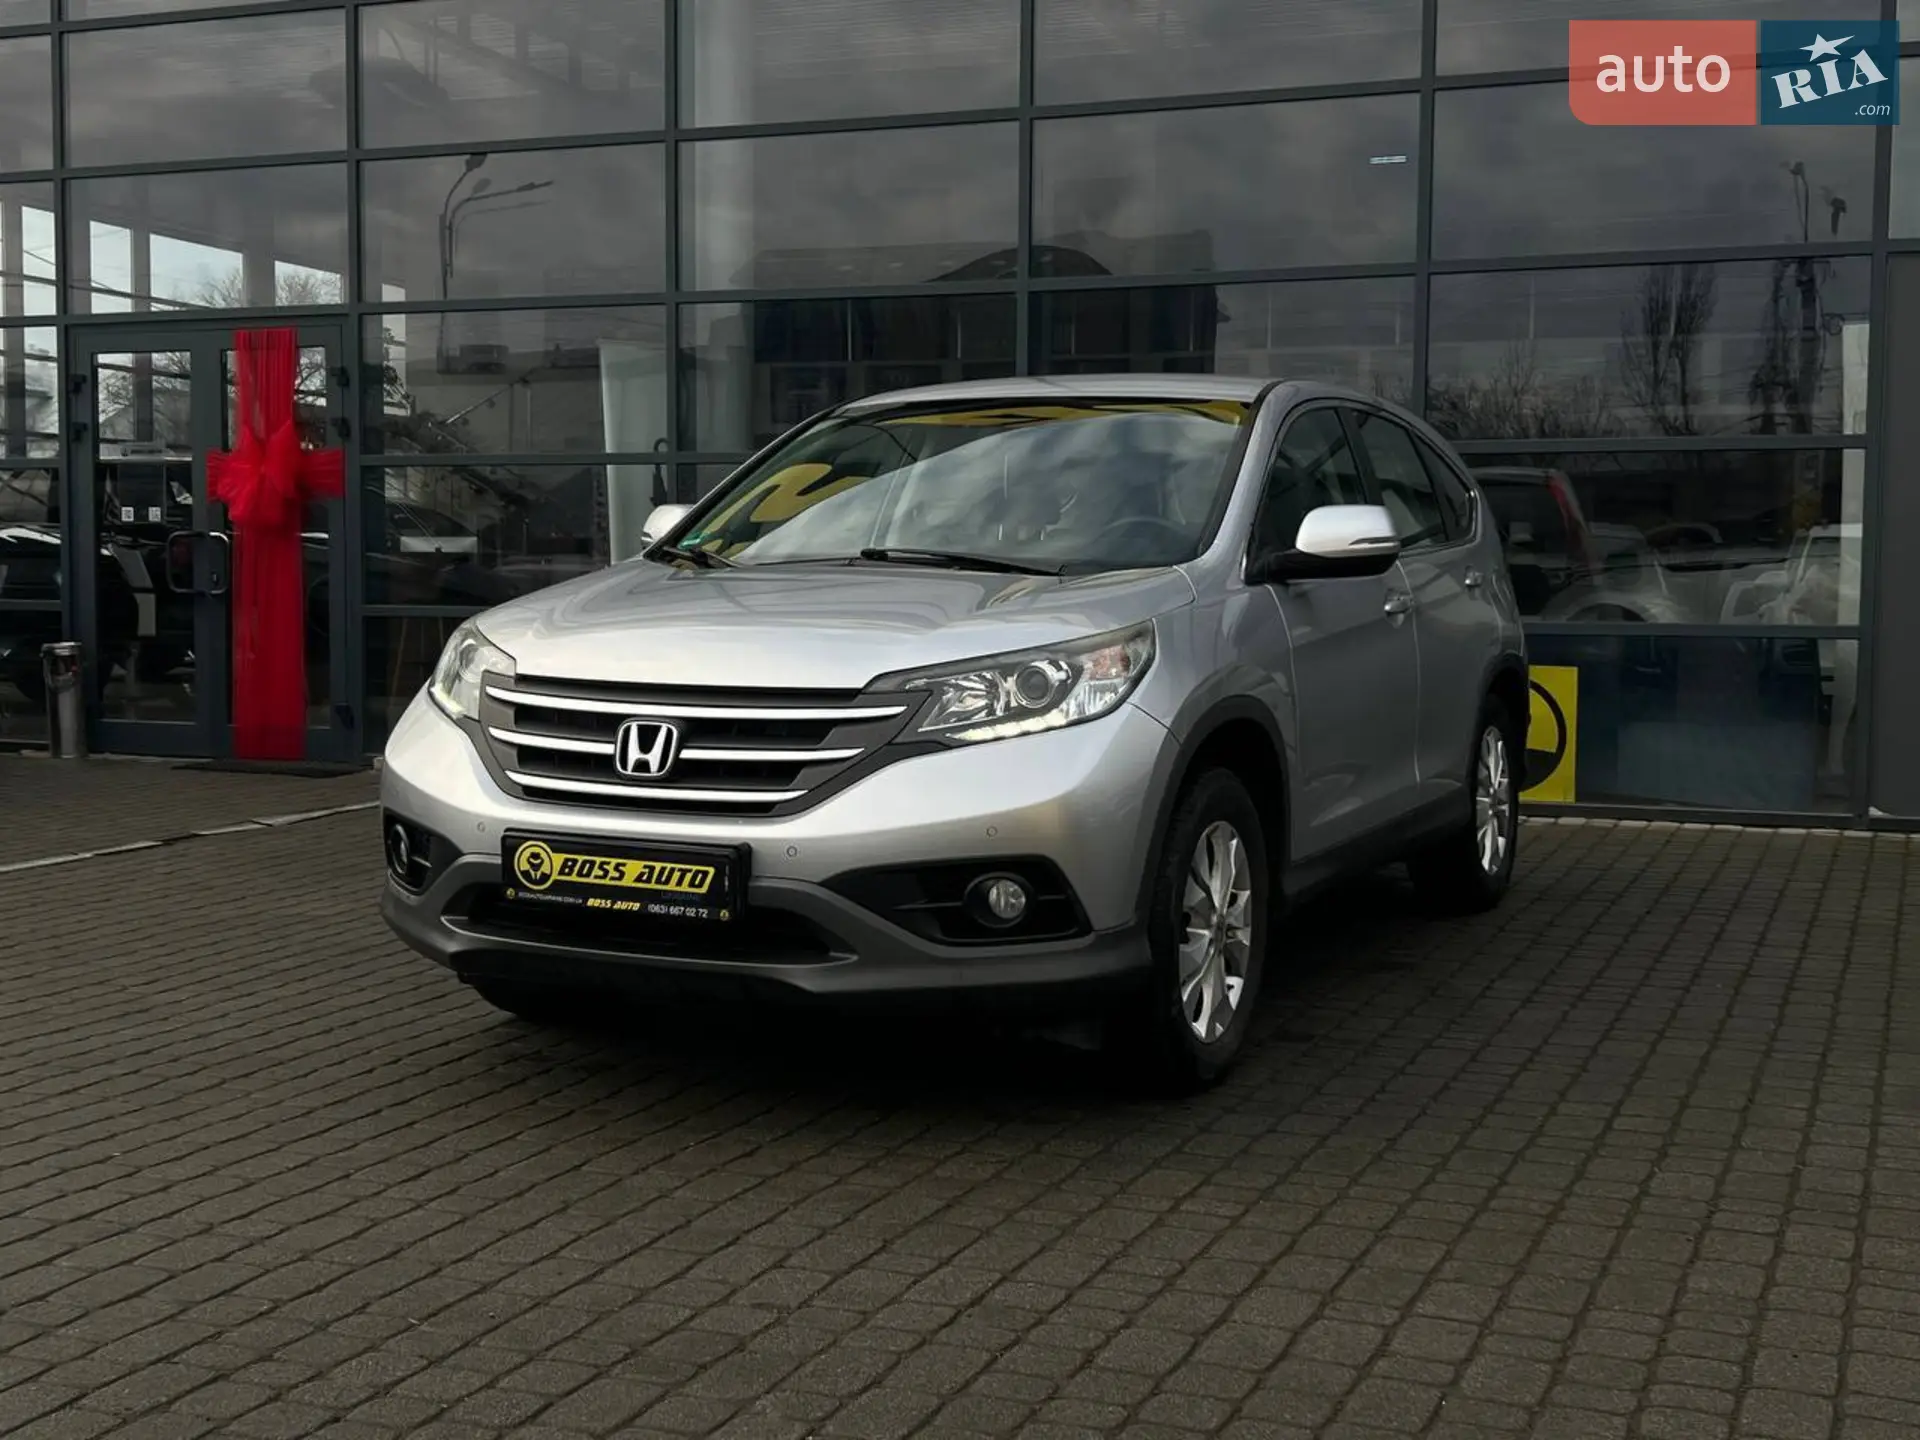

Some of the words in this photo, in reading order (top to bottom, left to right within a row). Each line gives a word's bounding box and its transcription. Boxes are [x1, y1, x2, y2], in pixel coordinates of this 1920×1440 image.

[557, 857, 627, 881] BOSS
[633, 864, 711, 889] AUTO
[586, 897, 612, 908] BOSS
[612, 900, 641, 911] AUTO
[685, 907, 697, 917] 02
[697, 908, 709, 918] 72
